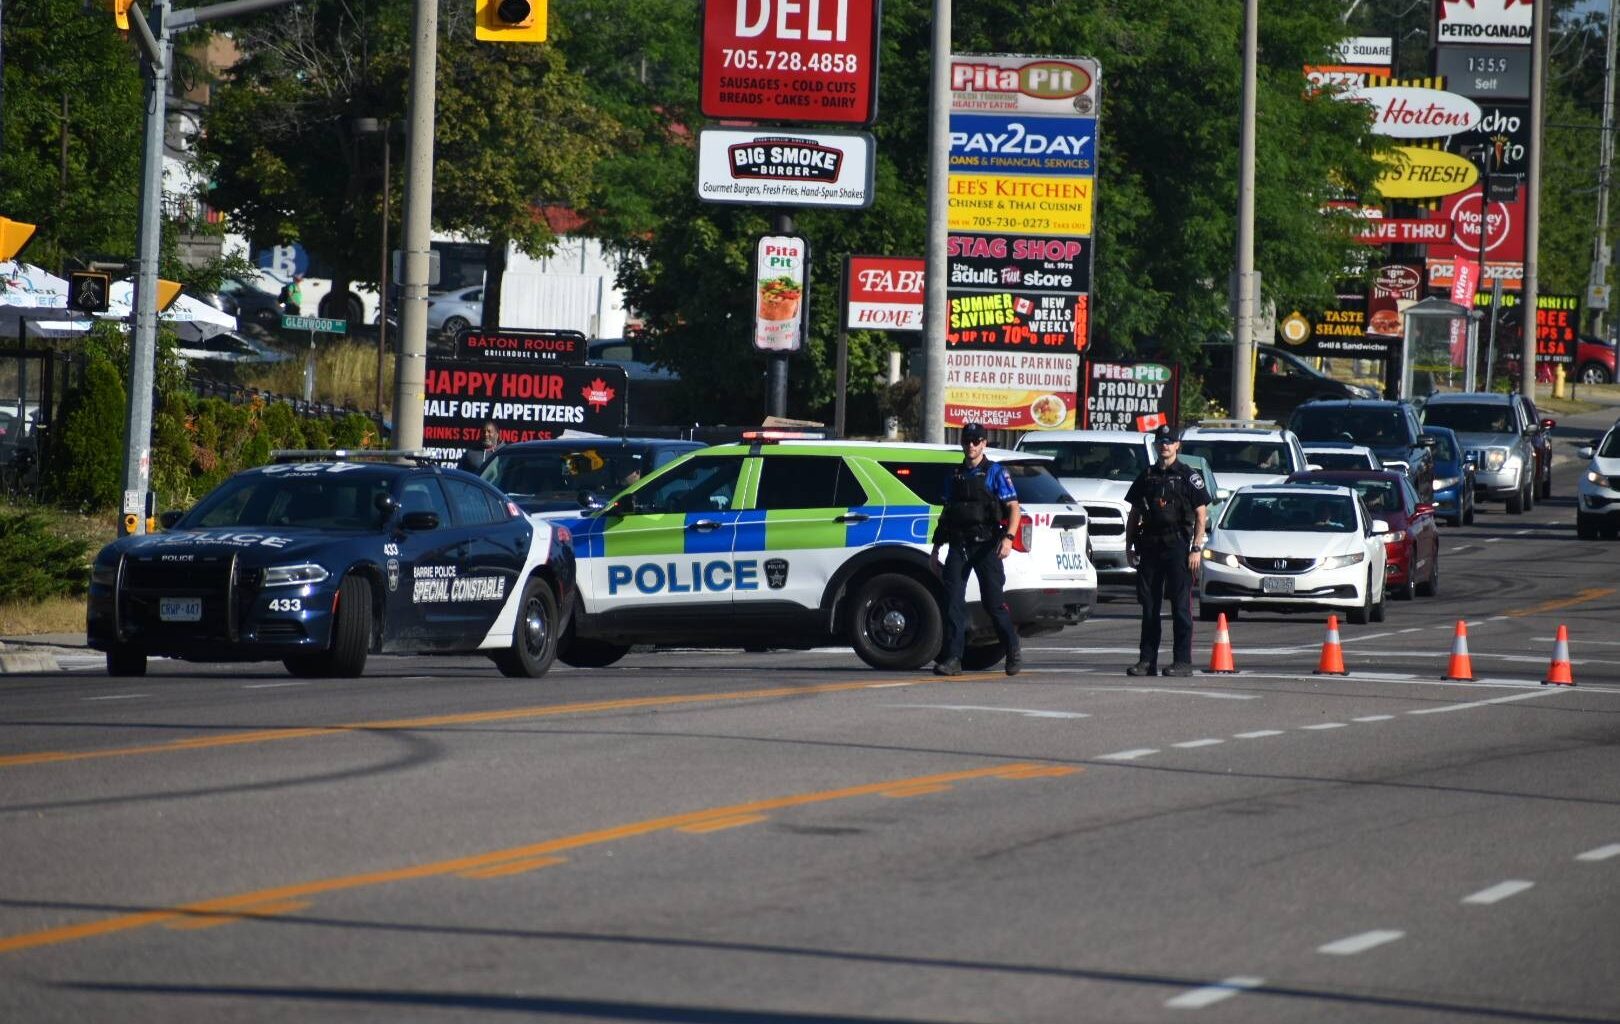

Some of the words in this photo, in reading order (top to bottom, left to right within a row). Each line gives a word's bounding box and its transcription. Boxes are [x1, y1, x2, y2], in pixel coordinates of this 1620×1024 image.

[735, 0, 848, 41] DELI
[1353, 46, 1391, 56] SQUARE
[722, 49, 857, 73] 705.728.4858
[1468, 57, 1507, 72] 135.9
[719, 77, 780, 90] SAUSAGES
[792, 80, 823, 92] COLD
[827, 82, 856, 93] CUTS
[953, 64, 1018, 91] Pita
[1028, 68, 1073, 91] Pit
[1475, 77, 1497, 90] Self
[719, 92, 764, 105] BREADS
[774, 94, 811, 106] CAKES
[821, 96, 856, 108] DAIRY
[989, 102, 1018, 110] EATING
[1383, 97, 1469, 126] Hortons
[949, 122, 1090, 155] PAY2DAY
[734, 147, 765, 166] BIG
[771, 147, 837, 170] SMOKE
[949, 156, 979, 165] OANS
[991, 157, 1041, 168] FINANCIAL
[1044, 160, 1090, 169] SERVICES
[760, 166, 810, 176] BURGER
[1407, 165, 1469, 183] FRESH
[703, 181, 733, 195] Gourmet
[733, 183, 762, 196] Burgers,
[763, 184, 781, 196] Fresh
[783, 184, 800, 197] Fries,
[801, 186, 838, 199] Hand-Spun
[947, 178, 988, 195] LEE'S
[996, 180, 1087, 198] KITCHEN
[948, 198, 993, 209] CHINESE
[1010, 200, 1036, 210] THAI
[1039, 202, 1083, 212] CUISINE
[972, 216, 1050, 229] 705-730-0273
[1459, 211, 1502, 226] Moey
[1401, 223, 1447, 238] THRU
[1463, 223, 1497, 234] Mat
[765, 245, 798, 256] Pita
[947, 236, 1007, 259] STAG
[1013, 239, 1082, 261] SHOP
[770, 257, 792, 267] Pit
[953, 263, 969, 271] the
[951, 268, 998, 284] adult
[1023, 270, 1073, 287] store
[952, 294, 1013, 313] SUMMER
[1041, 297, 1065, 309] NEW
[285, 317, 333, 330] GLENWOOD
[858, 309, 912, 327] HOME
[951, 308, 1015, 329] SAVINGS
[1034, 309, 1072, 321] DEALS
[1324, 311, 1365, 322] TASTE
[1536, 309, 1568, 327] REE
[962, 331, 977, 342] UP
[981, 331, 997, 342] TO
[1002, 325, 1039, 344] 70%
[1043, 334, 1067, 345] OFF
[1028, 321, 1075, 333] WEEKLY
[525, 338, 575, 351] ROUGE
[947, 355, 1017, 368] ADDITIONAL
[1021, 356, 1072, 370] PARKING
[948, 370, 961, 382] AT
[965, 372, 995, 384] REAR
[1000, 372, 1014, 384] OF
[1018, 374, 1071, 386] BUILDING
[1093, 364, 1133, 379] Pita
[1135, 365, 1164, 380] Pit
[502, 373, 564, 400] HOUR
[1098, 382, 1165, 398] PROUDLY
[461, 401, 490, 418] OFF
[492, 404, 584, 423] APPETIZERS
[1087, 397, 1158, 413] CANADIAN
[950, 409, 982, 418] LUNCH
[982, 410, 1022, 419] SPECIALS
[962, 417, 1009, 425] AVAILABLE
[1090, 412, 1112, 423] FOR
[1118, 413, 1132, 423] 30
[424, 427, 460, 440] RINKS
[521, 430, 536, 441] AT
[384, 544, 399, 556] 433
[1056, 553, 1083, 570] POLICE
[413, 567, 434, 578] BARRIE
[434, 566, 457, 577] POLICE
[607, 559, 760, 595] POLICE
[413, 579, 450, 602] SPECIAL
[451, 576, 506, 601] CONSTABLE
[269, 599, 301, 612] 433
